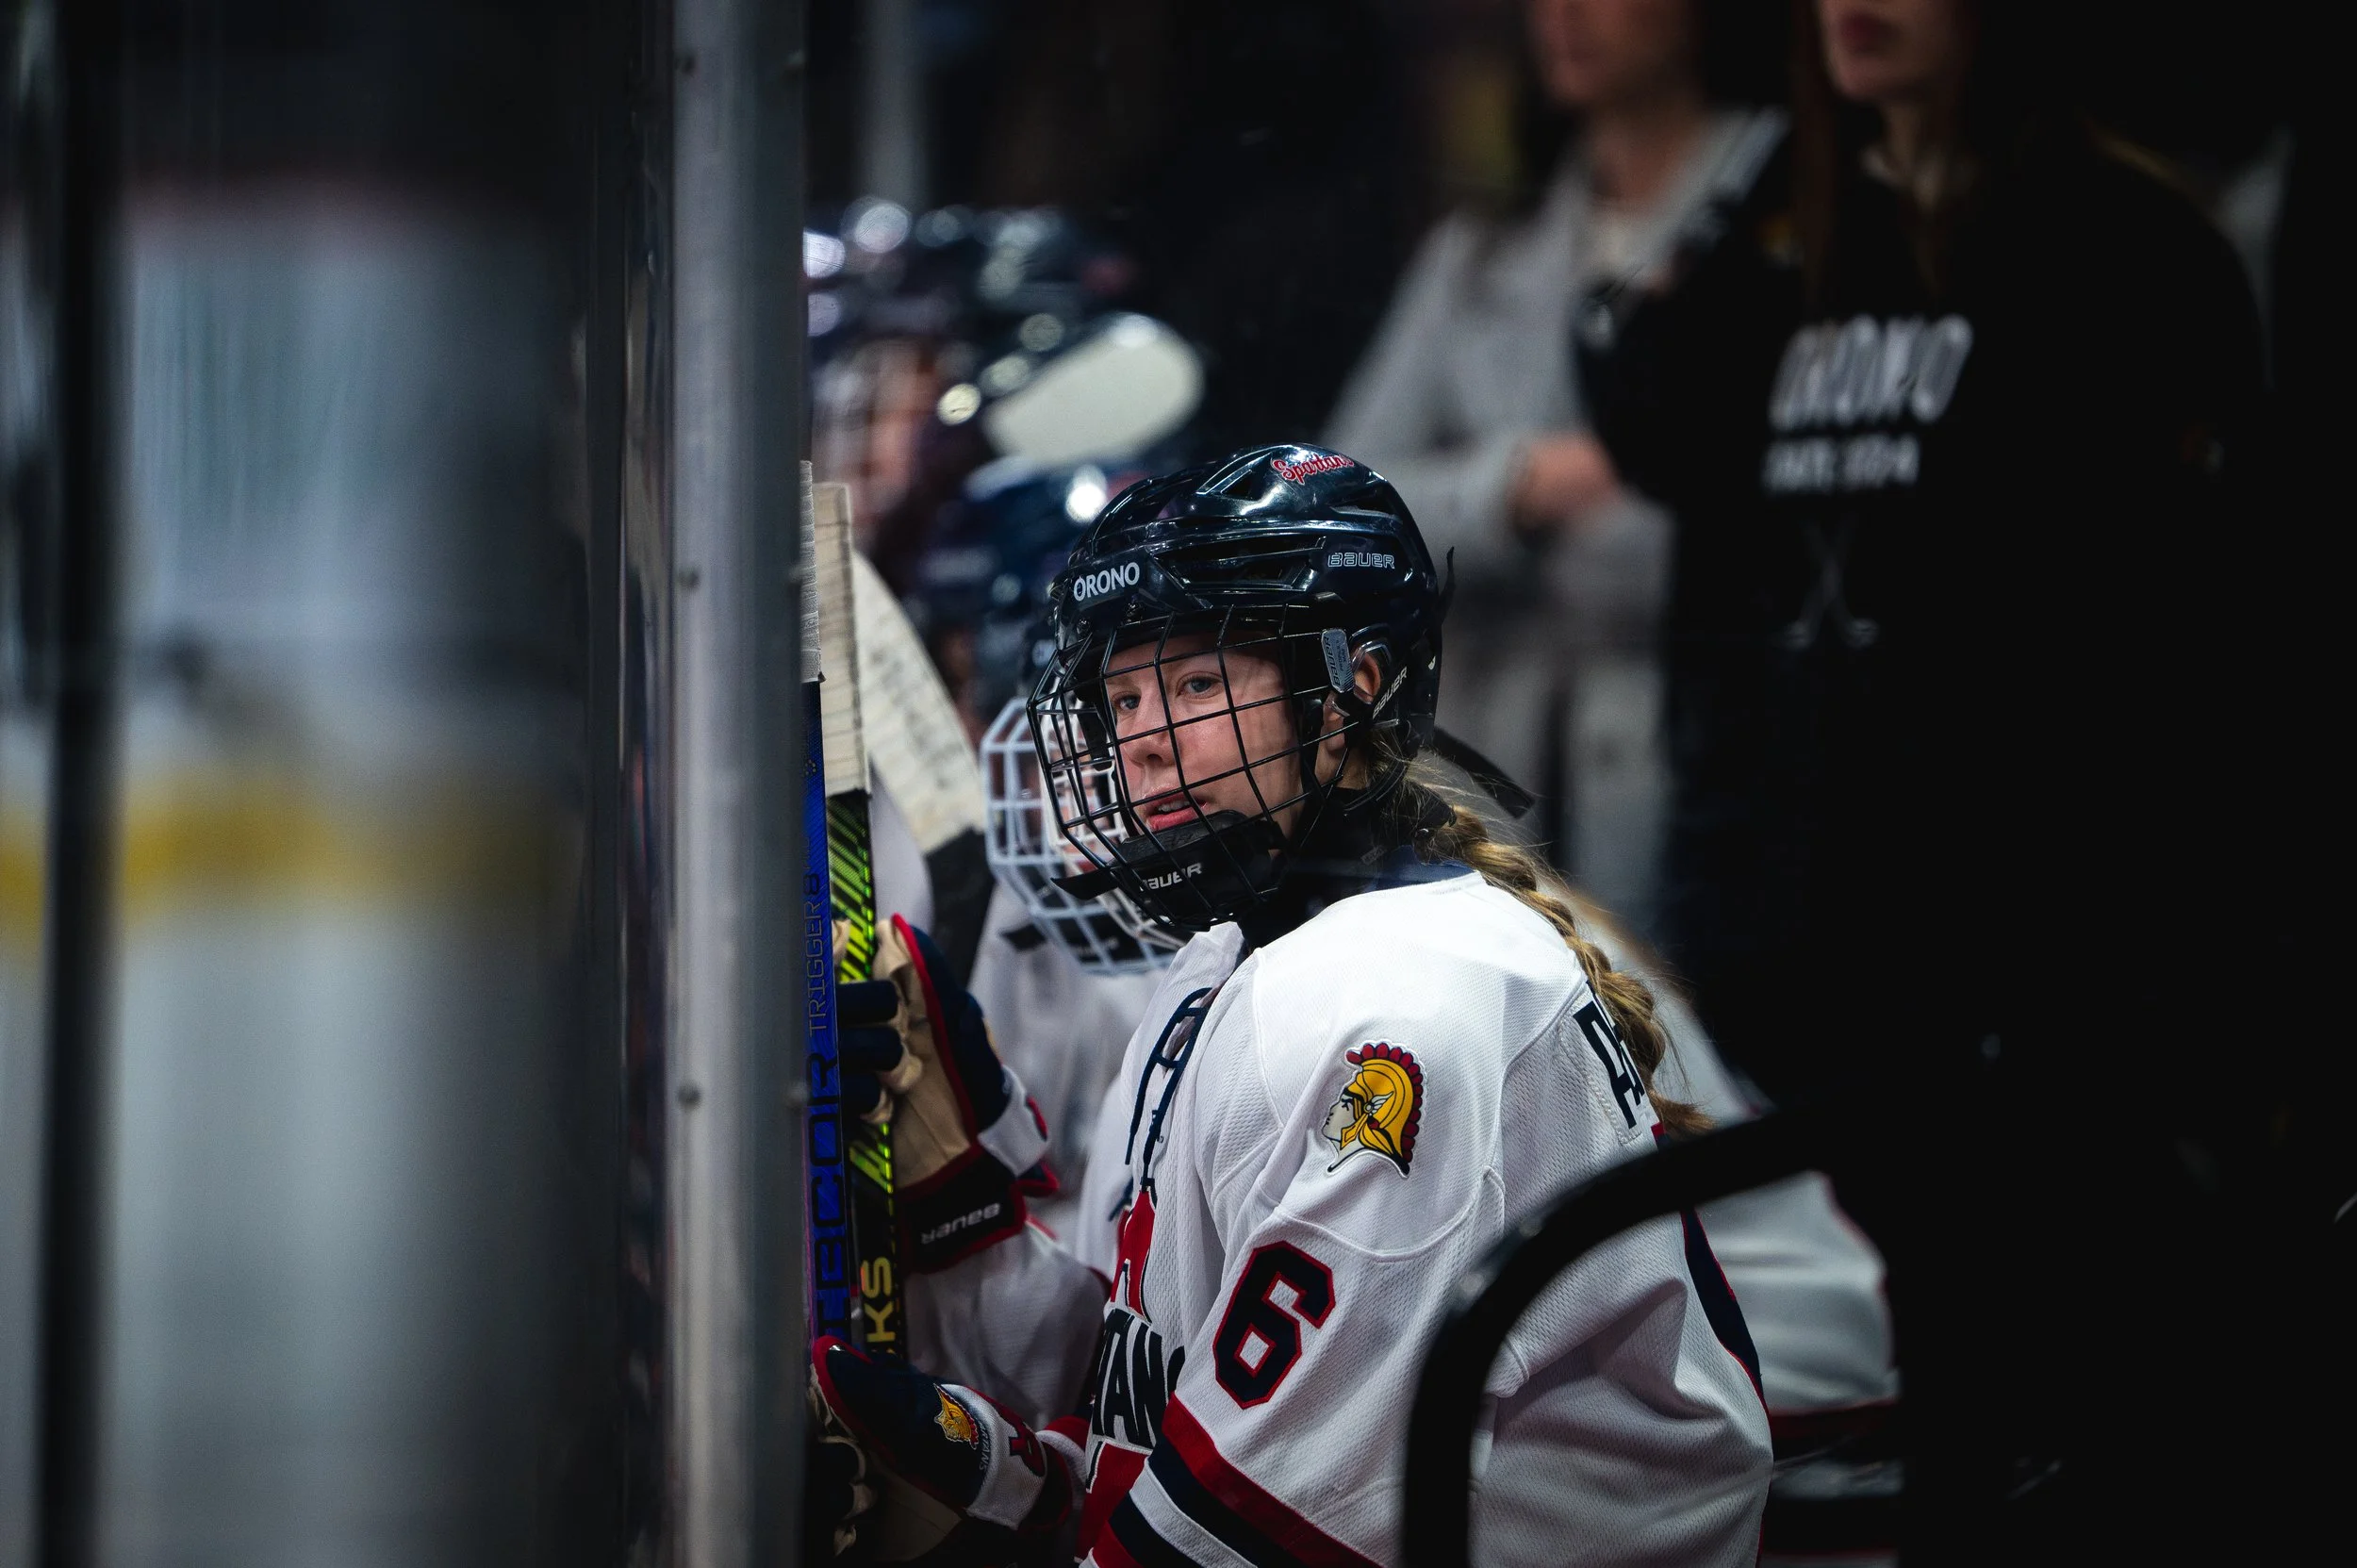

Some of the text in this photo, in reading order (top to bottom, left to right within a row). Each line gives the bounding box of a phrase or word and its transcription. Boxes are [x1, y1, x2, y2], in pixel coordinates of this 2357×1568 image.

[1073, 562, 1140, 602] ORONO
[1327, 553, 1395, 569] BAUER
[1372, 666, 1408, 719] BAUER
[803, 900, 829, 1037] TRIGGER
[806, 1053, 850, 1336] IBCOR
[860, 1255, 897, 1345] KS
[1212, 1240, 1335, 1410] 6
